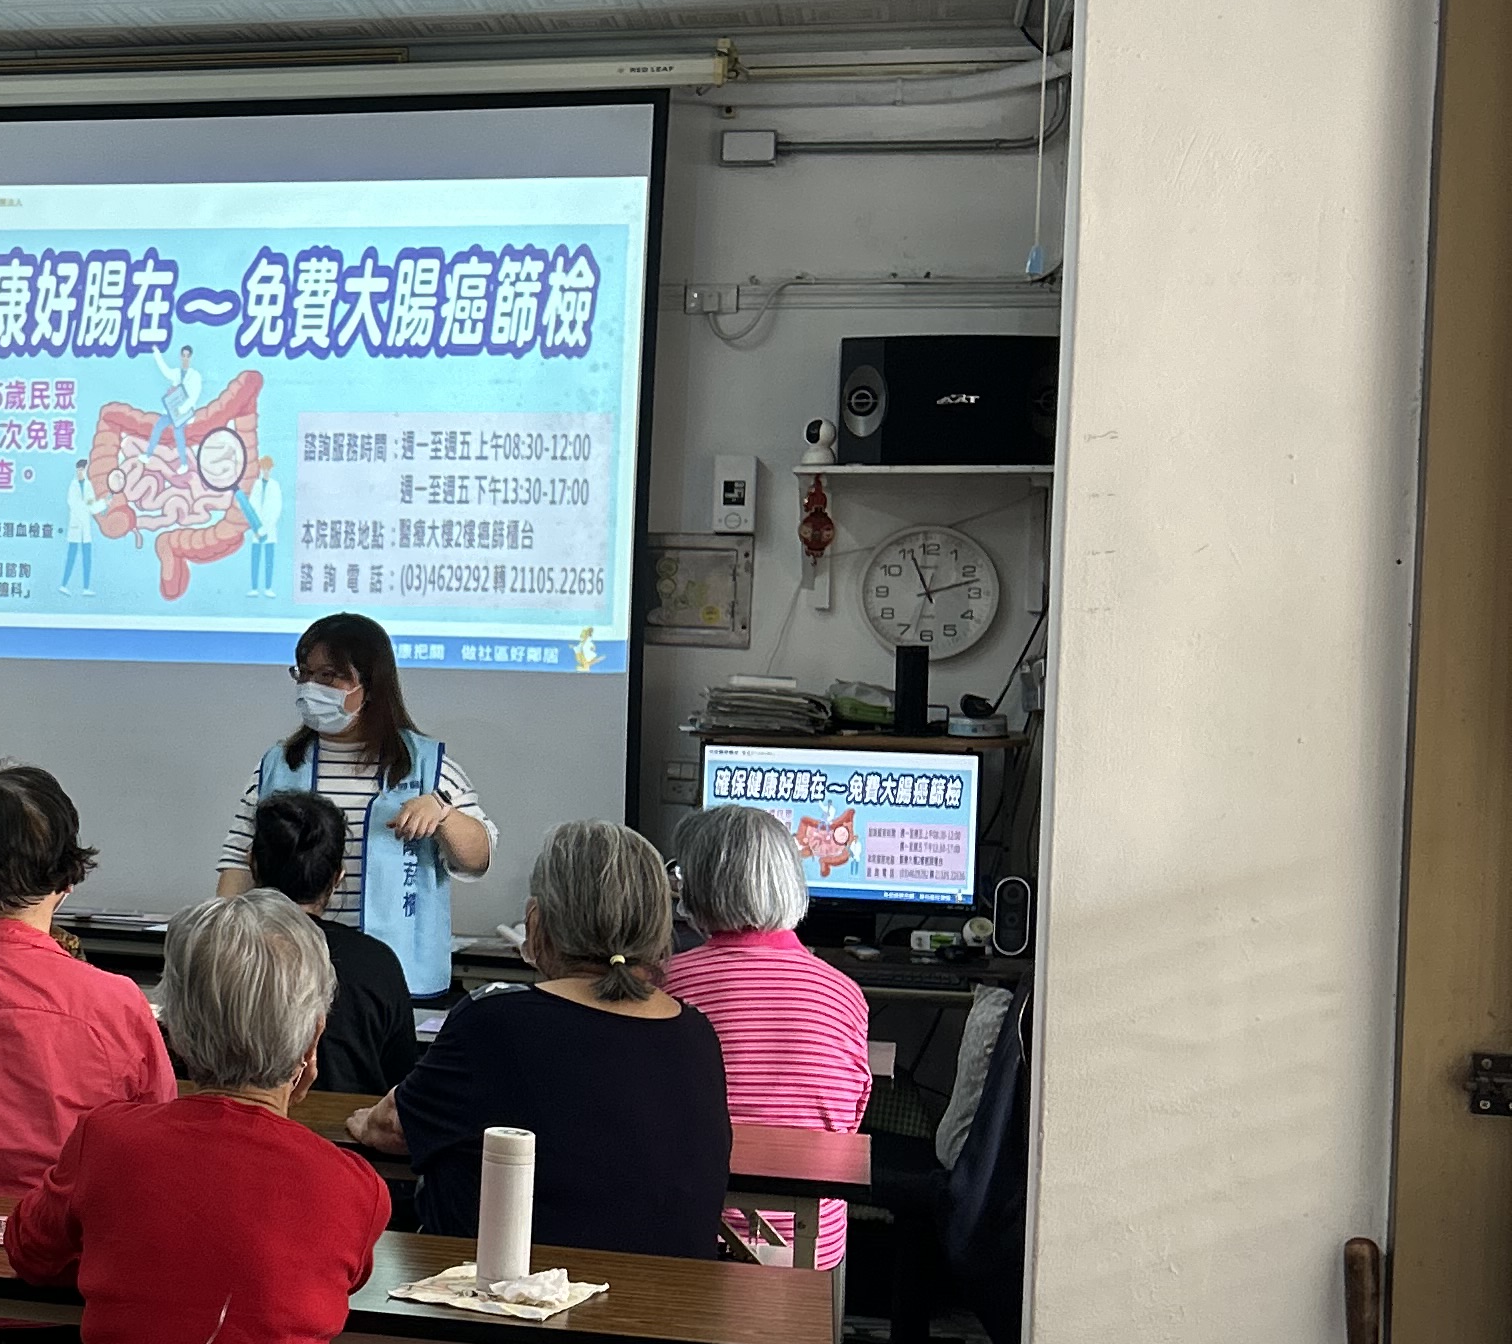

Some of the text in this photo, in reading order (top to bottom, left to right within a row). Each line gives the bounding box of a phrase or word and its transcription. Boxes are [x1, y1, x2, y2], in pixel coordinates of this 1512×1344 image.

[898, 548, 915, 561] 11
[919, 543, 940, 556] 12
[950, 549, 959, 561] 1
[880, 564, 903, 577] 10
[962, 565, 976, 577] 2
[875, 585, 889, 598] 9
[967, 587, 982, 599] 3
[880, 607, 895, 620] 8
[960, 609, 975, 620] 4
[897, 623, 911, 635] 7
[919, 629, 934, 642] 6
[943, 624, 958, 637] 5
[392, 643, 445, 661] 康把關
